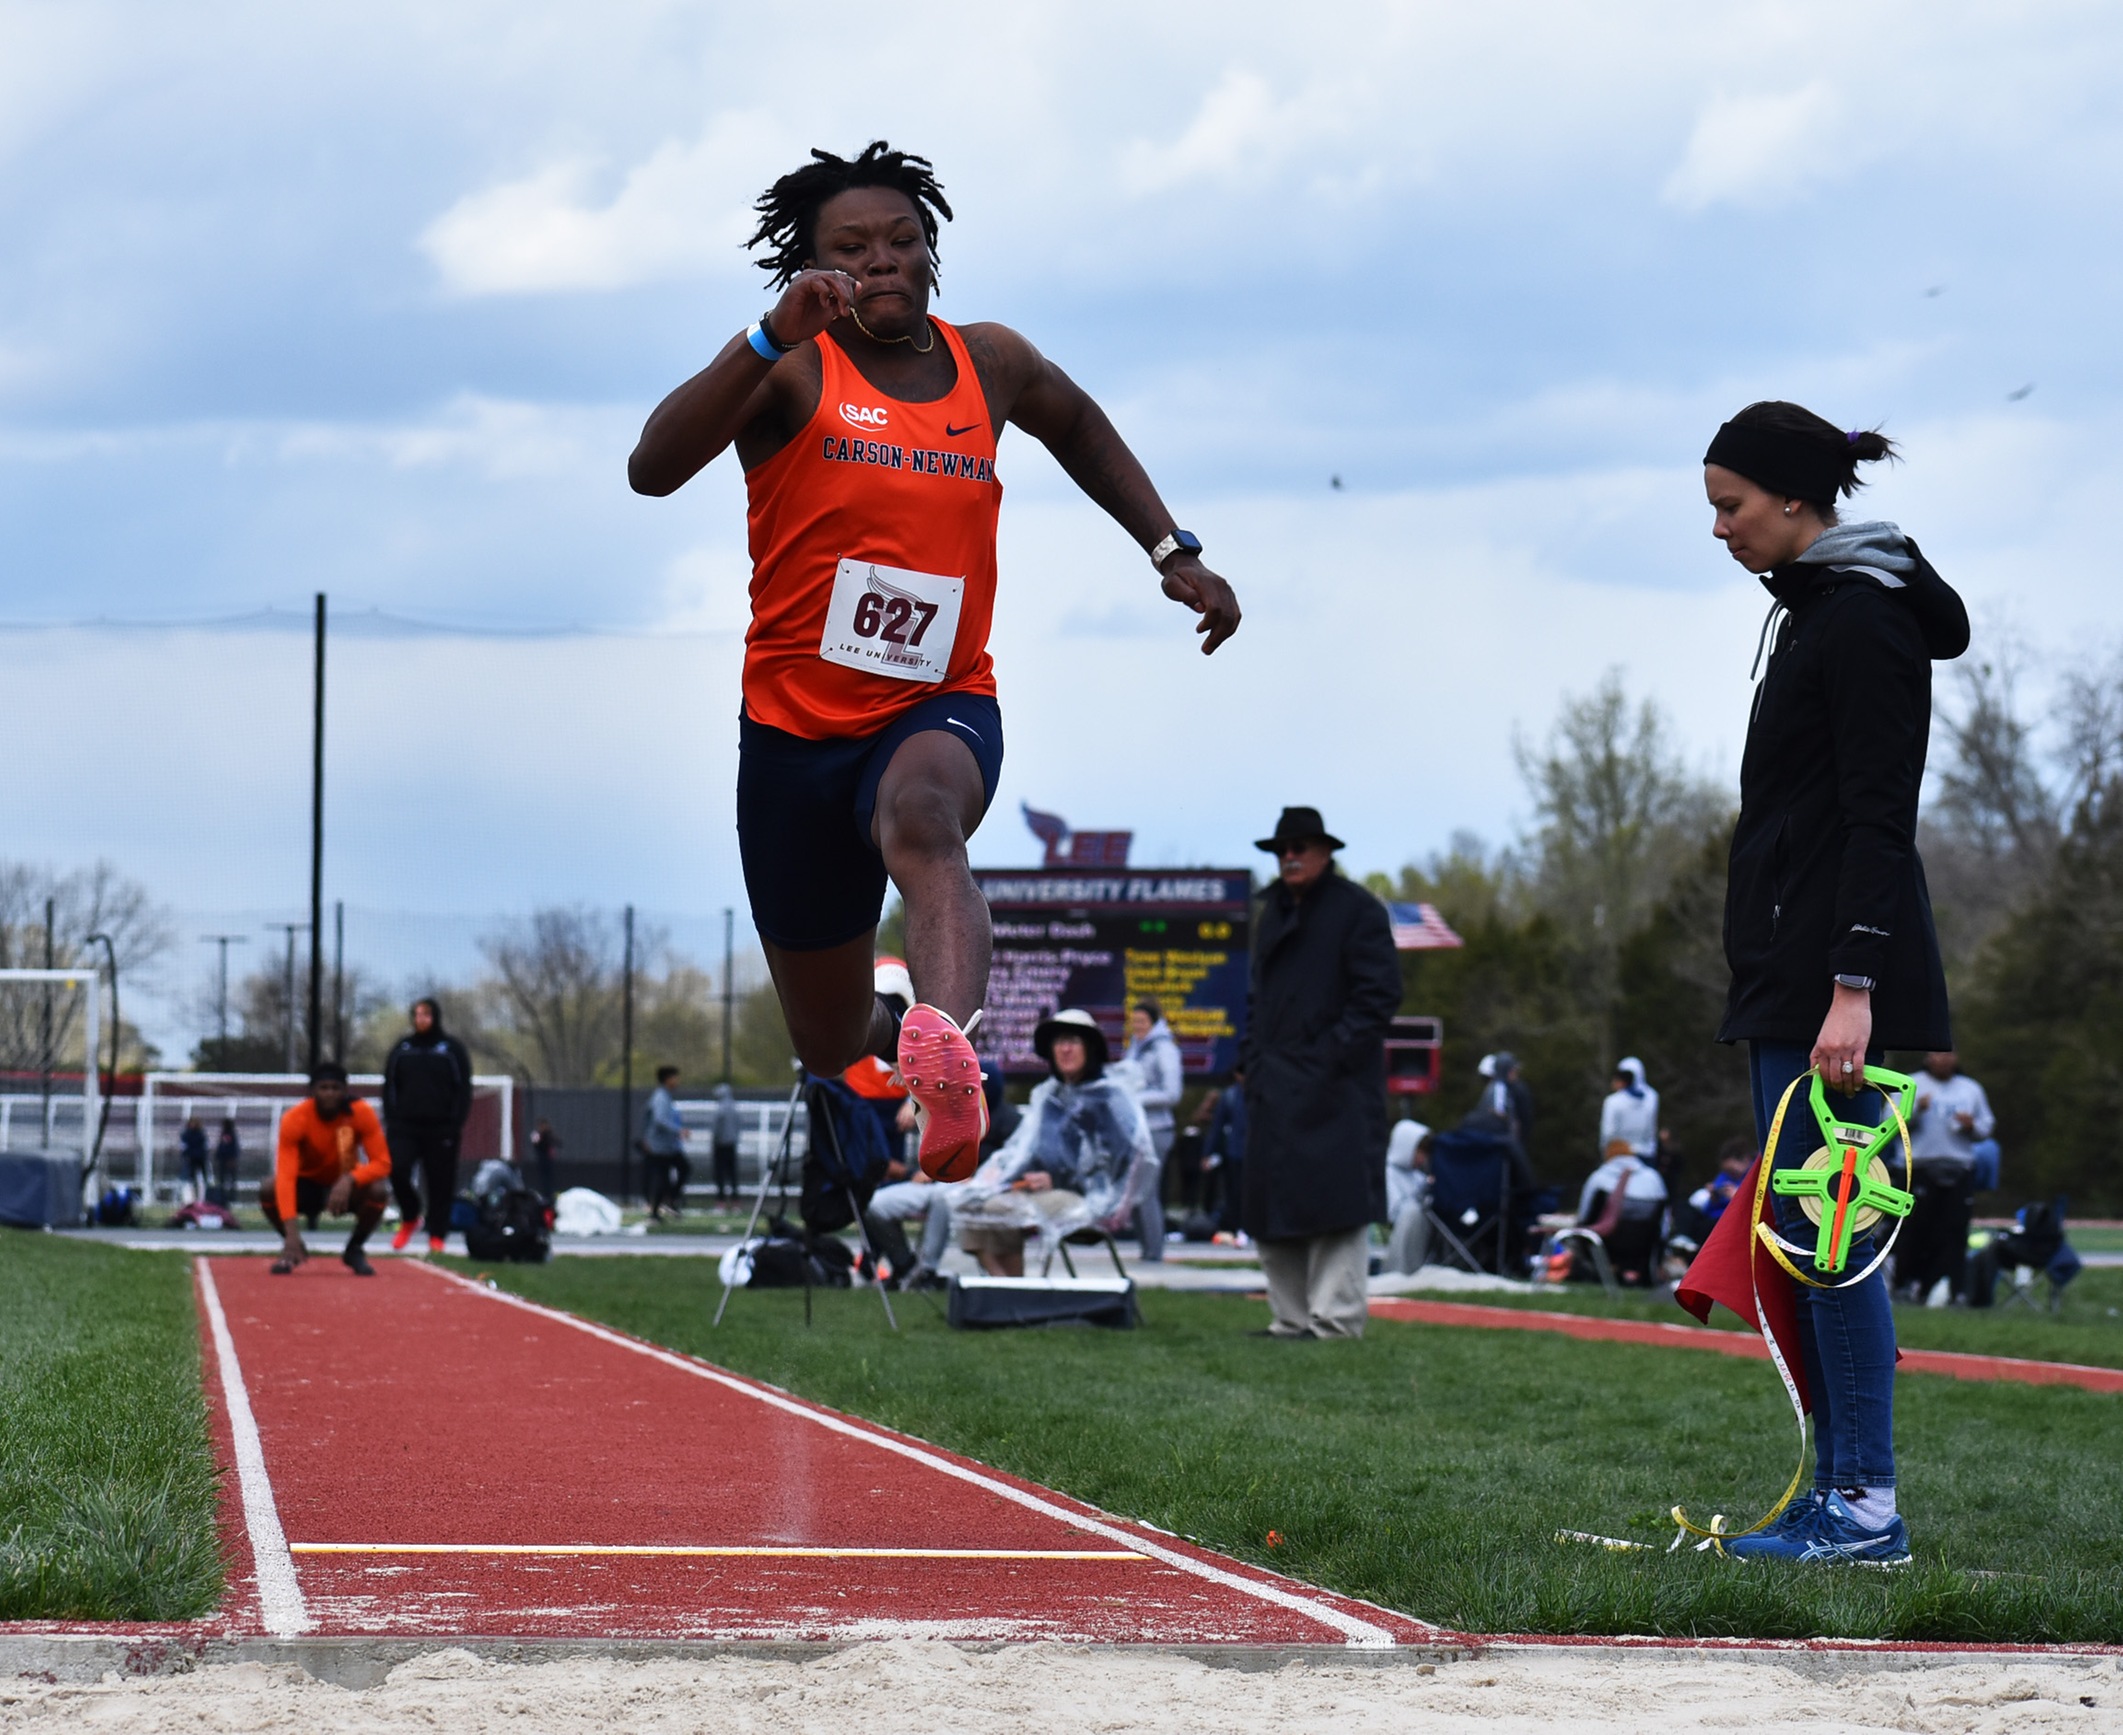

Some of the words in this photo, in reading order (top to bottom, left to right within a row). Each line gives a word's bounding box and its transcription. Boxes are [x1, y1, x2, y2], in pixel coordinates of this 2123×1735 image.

[845, 403, 888, 426] SAC
[823, 437, 993, 483] CARSON-NEWMAN
[853, 592, 939, 647] 627
[839, 643, 861, 654] LEE
[1126, 878, 1226, 901] FLAMES
